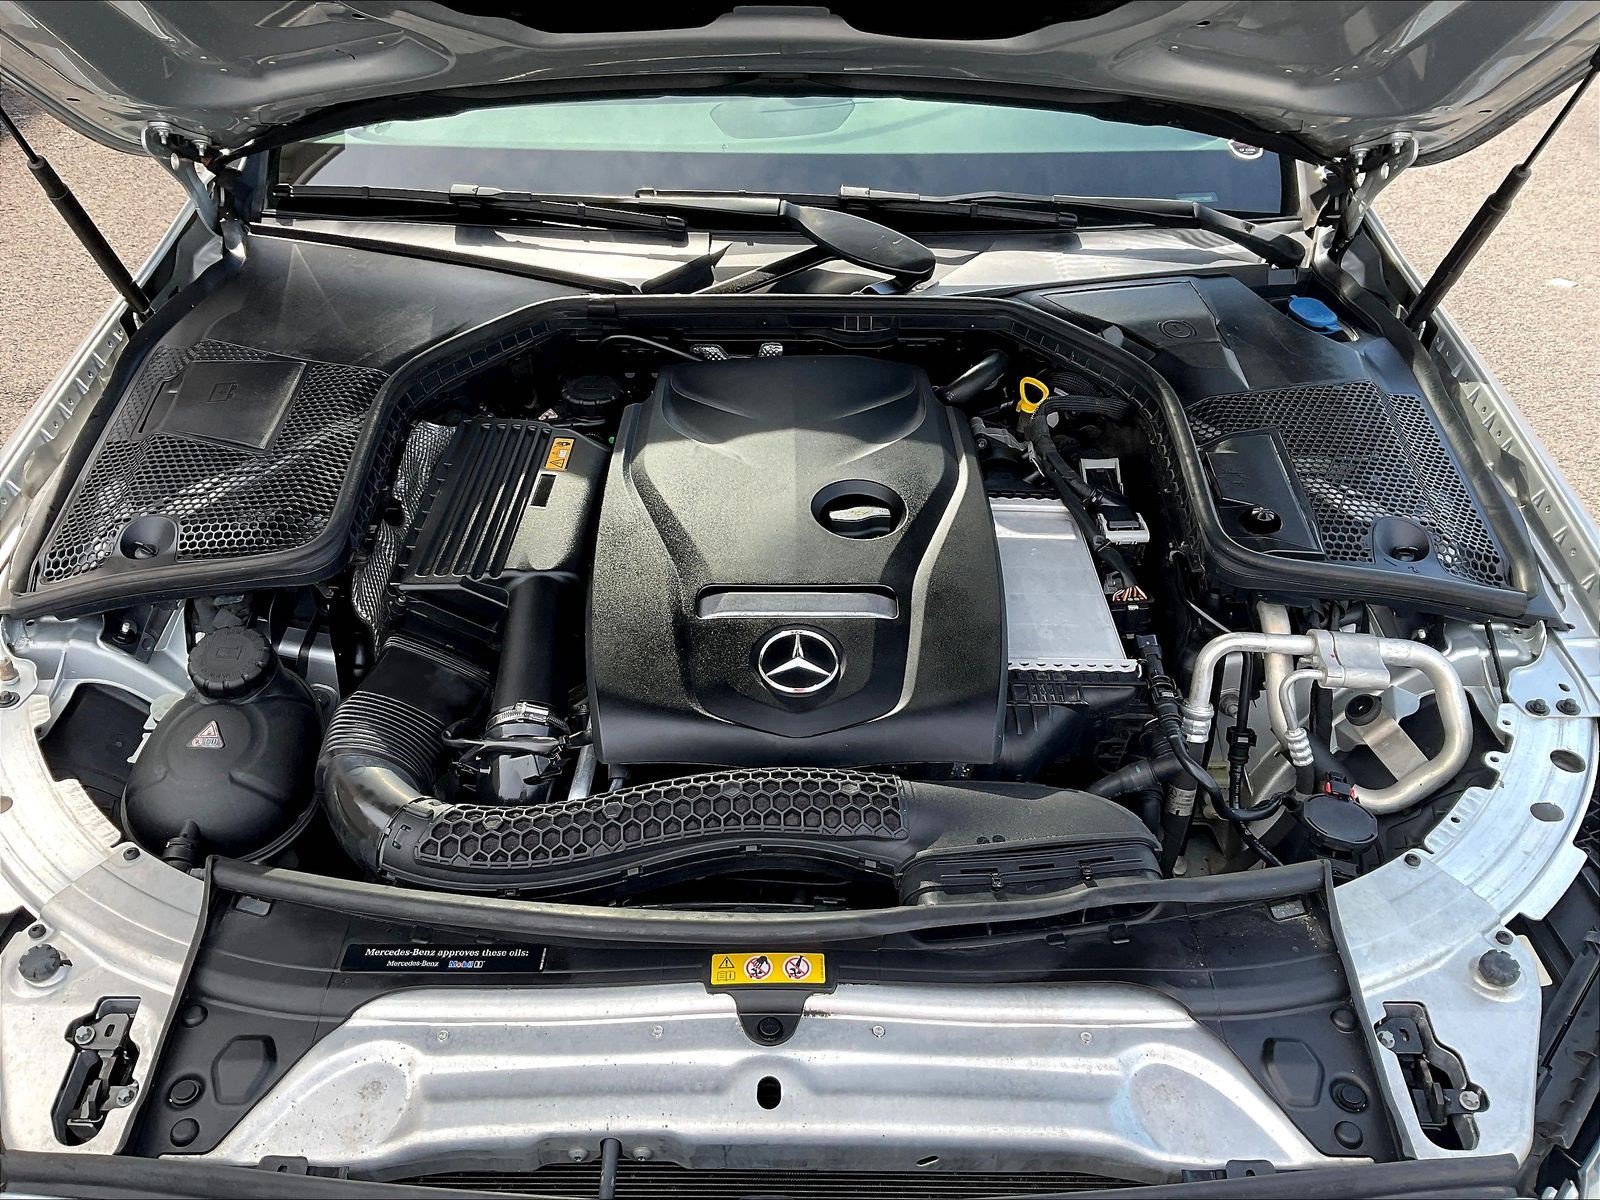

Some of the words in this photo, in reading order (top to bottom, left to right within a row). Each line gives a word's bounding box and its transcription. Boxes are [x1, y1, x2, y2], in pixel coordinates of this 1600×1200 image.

[365, 948, 436, 957] Mercedes-Benz
[437, 949, 480, 959] approves
[482, 949, 507, 957] these
[509, 949, 529, 957] oils:
